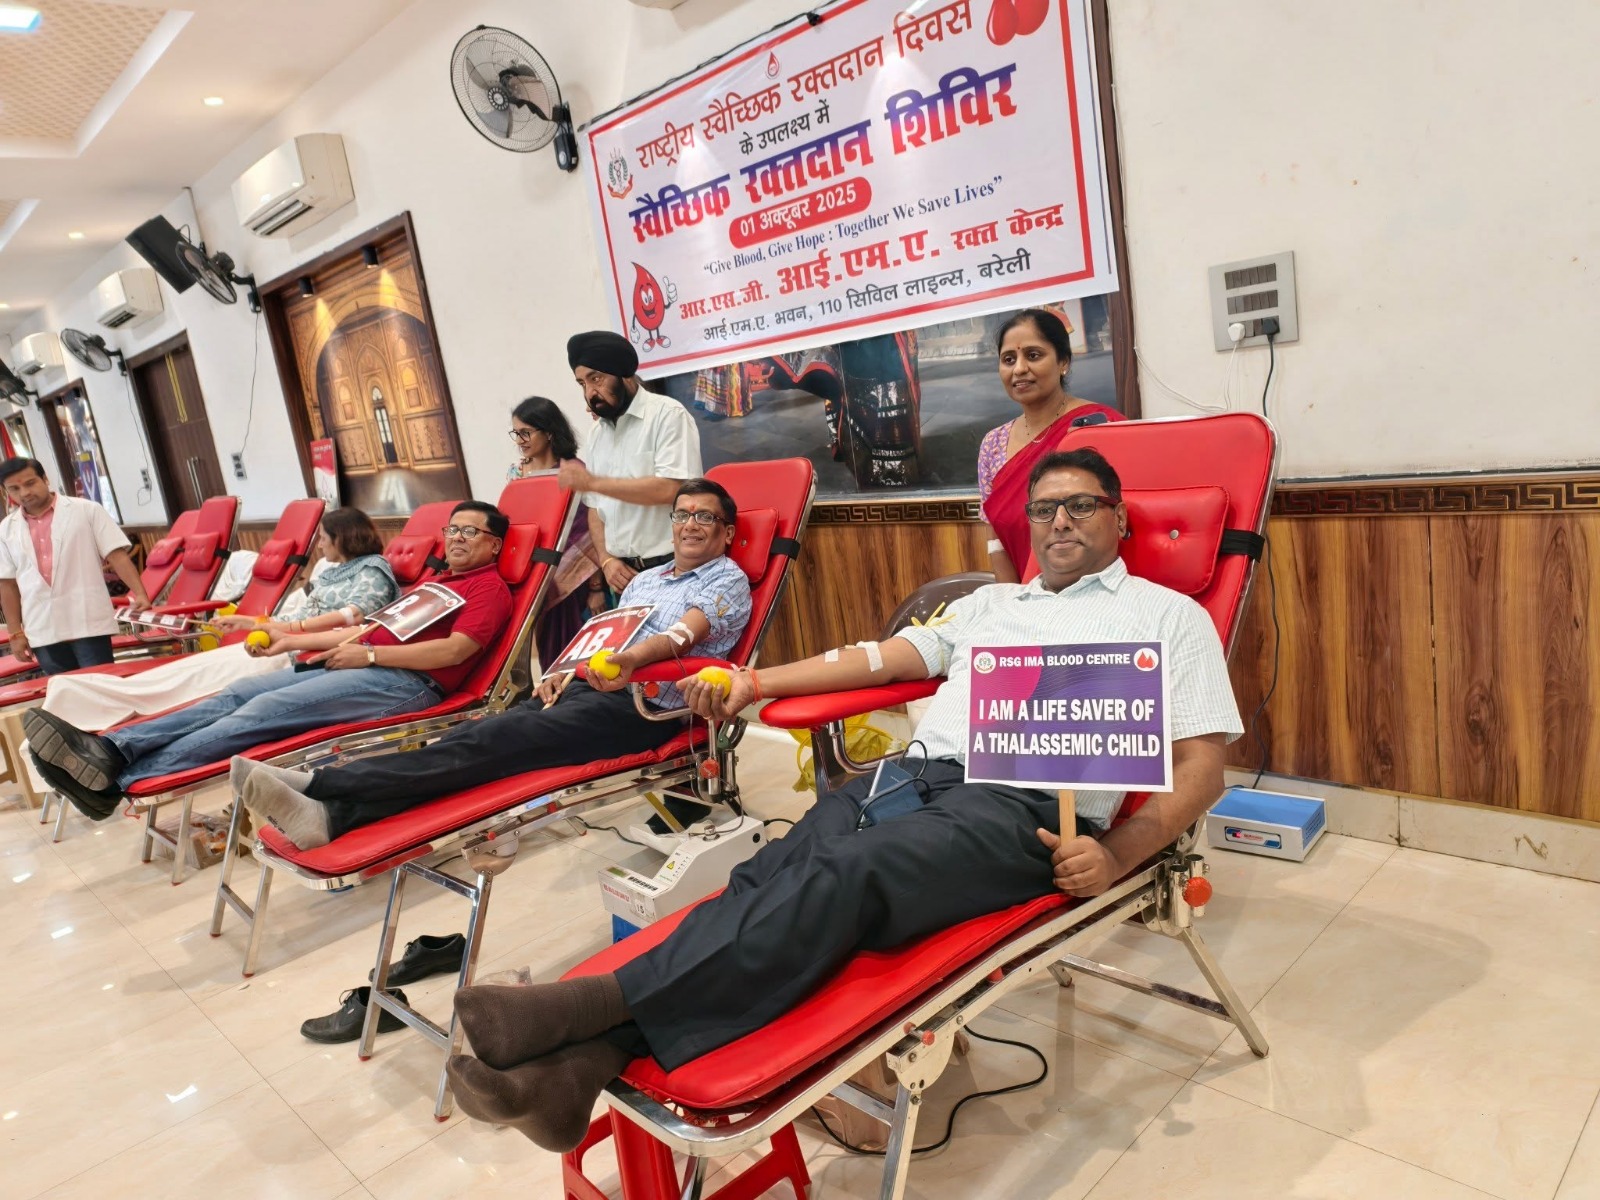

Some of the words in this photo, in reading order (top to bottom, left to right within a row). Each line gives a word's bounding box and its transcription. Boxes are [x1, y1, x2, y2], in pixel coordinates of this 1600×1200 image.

[635, 121, 695, 168] राष्ट्रीय
[701, 83, 781, 140] स्वैच्छिक
[787, 35, 884, 102] रक्तदान
[893, 0, 972, 58] दिवस
[628, 173, 731, 244] स्वैच्छिक
[739, 118, 874, 204] रक्तदान
[884, 62, 1017, 155] शिविर
[739, 132, 754, 156] के
[757, 112, 810, 149] उपलक्ष्य
[815, 99, 830, 124] में
[733, 248, 767, 268] Blood,
[768, 242, 793, 258] Give
[795, 232, 826, 251] Hope
[834, 212, 890, 238] Together
[892, 204, 915, 221] We
[918, 194, 951, 215] Save
[740, 217, 756, 237] 01
[759, 198, 811, 229] अक्टूबर
[816, 182, 857, 213] 2025
[679, 279, 770, 320] आर.एस.जी.
[951, 221, 999, 251] रक्त
[1006, 203, 1064, 236] केन्द्र
[703, 315, 770, 341] आई.एम.ए.
[775, 305, 813, 325] भवन,
[818, 298, 842, 316] 110
[845, 283, 898, 310] सिविल
[903, 268, 972, 296] लाइन्स,
[977, 247, 1031, 278] बरेली
[383, 594, 420, 615] B
[559, 627, 613, 664] AB
[999, 656, 1022, 667] RSG
[1024, 655, 1044, 667] IMA
[1047, 654, 1083, 666] BLOOD
[1086, 653, 1131, 665] CENTRE
[979, 699, 984, 720] I
[988, 699, 1014, 720] AM
[1018, 700, 1029, 721] A
[1033, 699, 1067, 721] LIFE
[1070, 699, 1127, 721] SAVER
[1131, 698, 1155, 721] OF
[973, 732, 985, 753] A
[988, 732, 1102, 755] THALASSEMIC
[1107, 733, 1160, 757] CHILD
